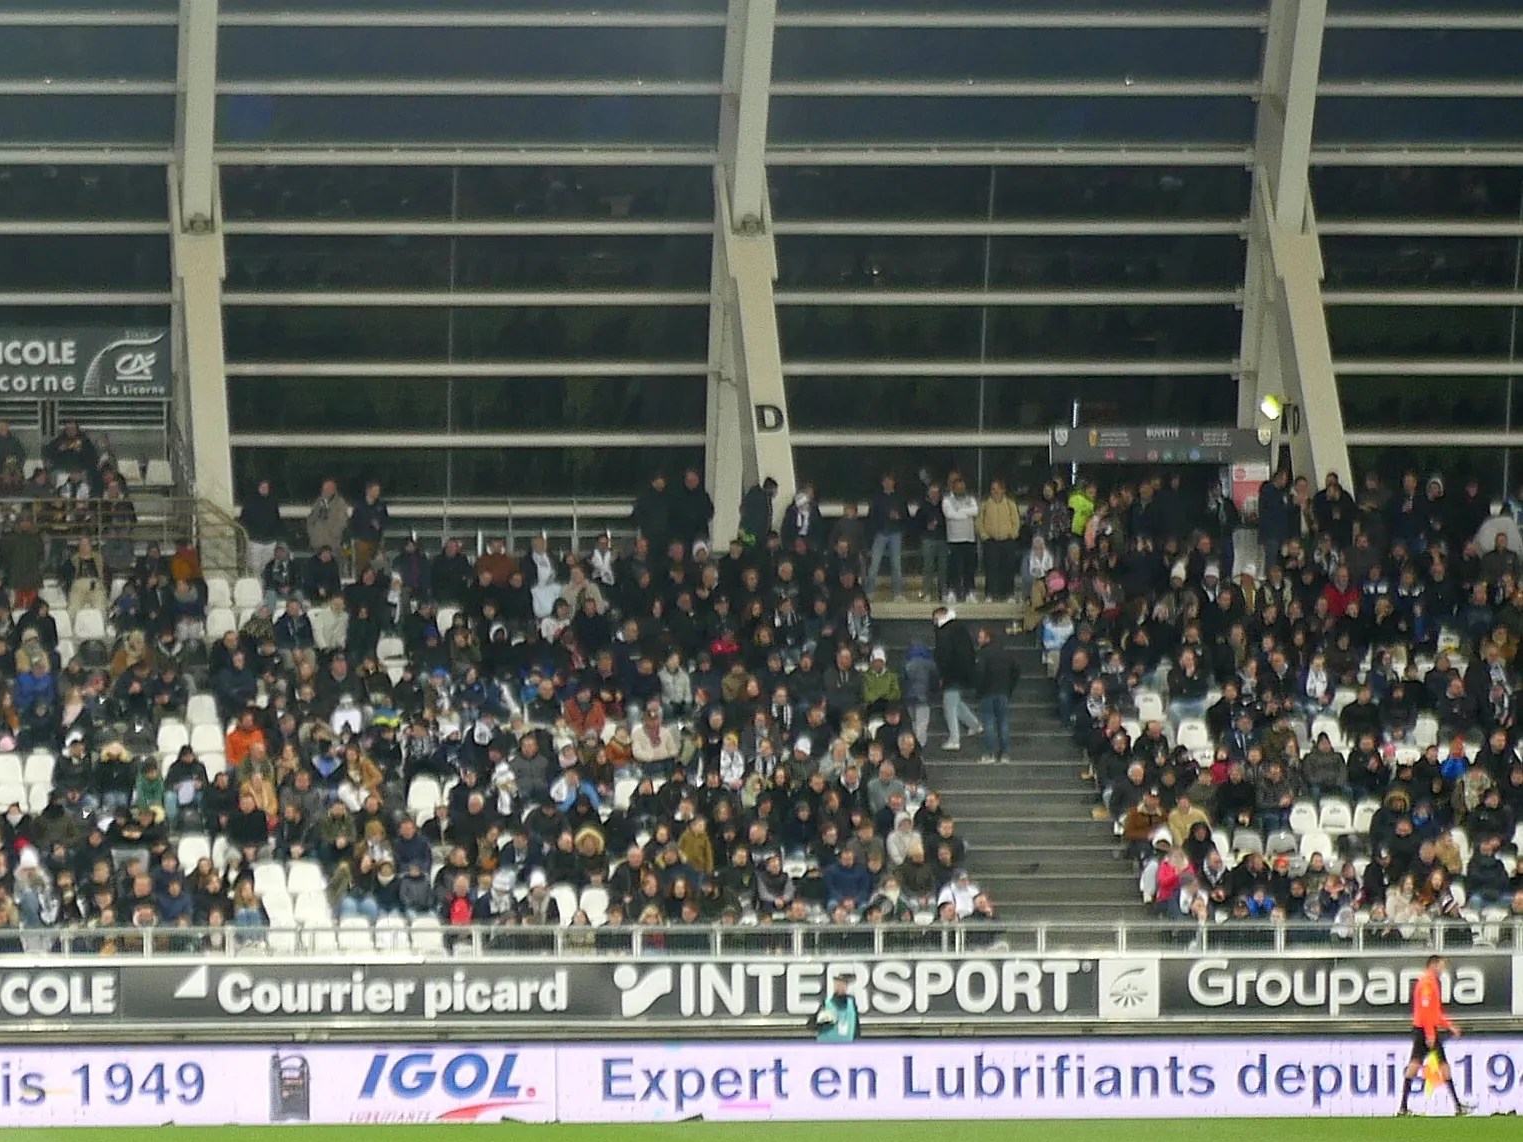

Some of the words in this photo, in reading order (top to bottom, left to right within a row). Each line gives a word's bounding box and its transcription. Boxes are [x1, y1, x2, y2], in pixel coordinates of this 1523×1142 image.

[755, 404, 784, 433] D
[217, 970, 415, 1014] Courrier
[424, 970, 568, 1020] picard
[681, 961, 1080, 1015] INTERSPORT
[73, 1062, 206, 1107] 1949
[602, 1058, 788, 1111] Expert
[810, 1067, 877, 1099] en
[902, 1055, 1216, 1099] Lubrifiants
[1454, 1053, 1523, 1098] 19
